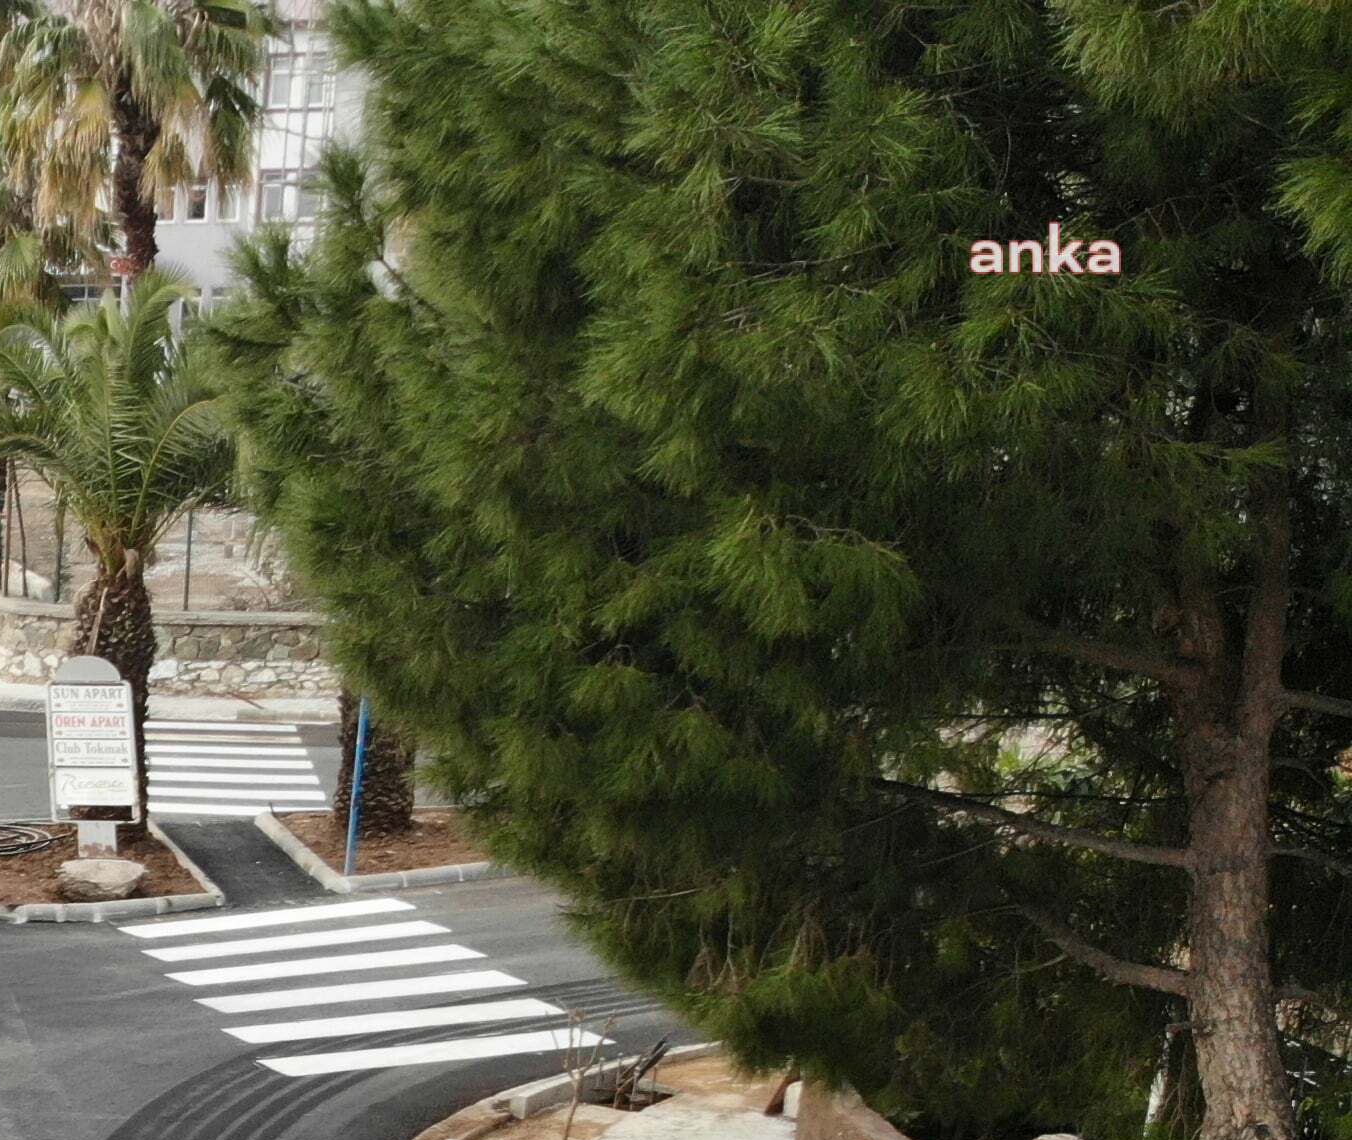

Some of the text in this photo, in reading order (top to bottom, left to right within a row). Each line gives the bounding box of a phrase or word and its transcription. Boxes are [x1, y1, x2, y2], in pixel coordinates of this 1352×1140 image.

[53, 688, 123, 699] SUN APART
[90, 715, 125, 728] APART
[56, 741, 81, 753] Club
